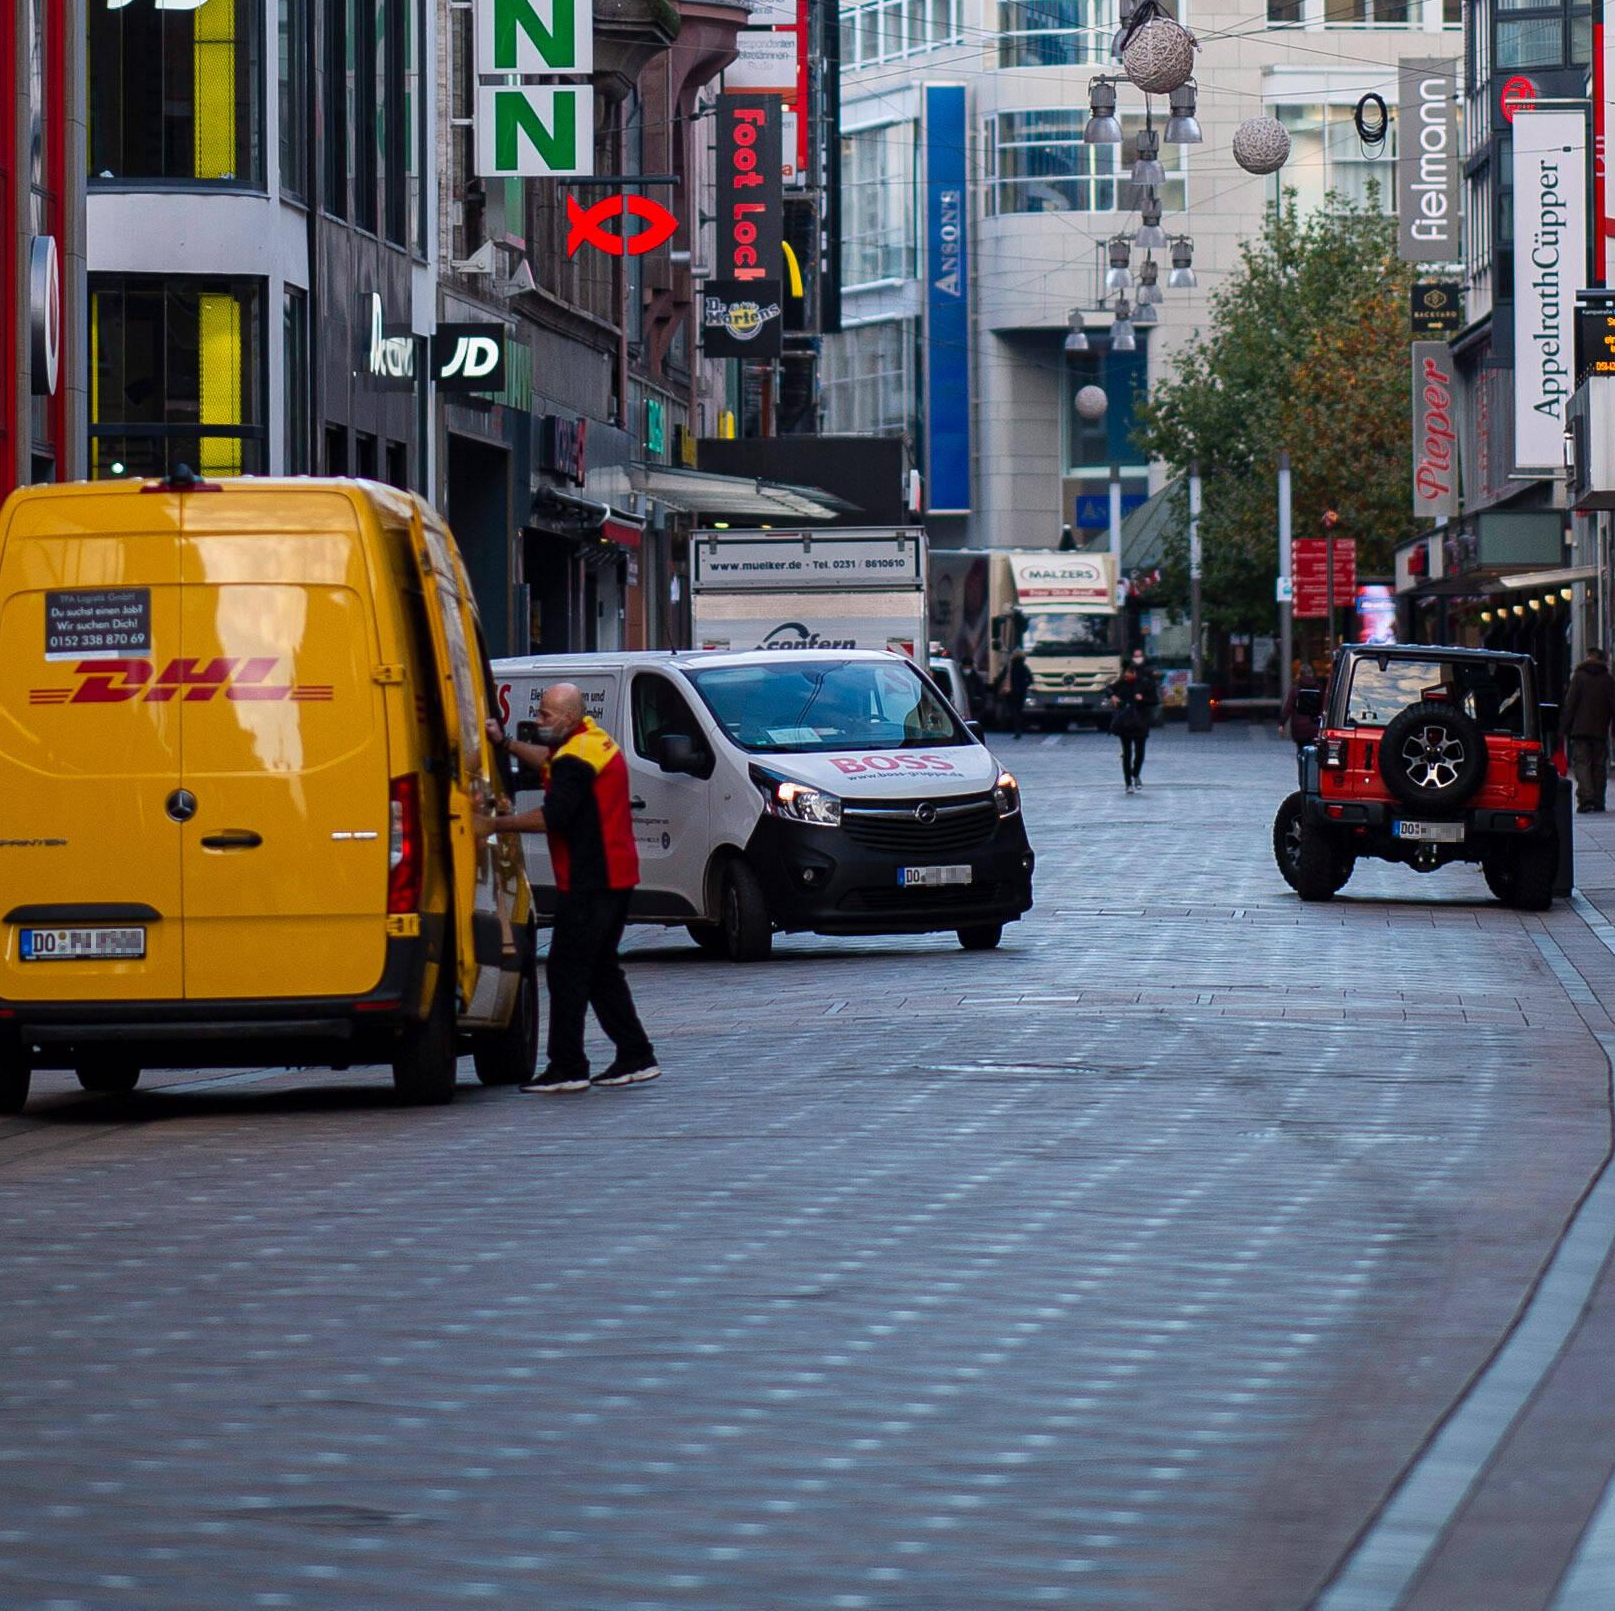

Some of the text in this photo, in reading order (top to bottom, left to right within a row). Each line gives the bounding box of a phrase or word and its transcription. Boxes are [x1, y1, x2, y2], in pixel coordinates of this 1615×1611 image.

[733, 109, 766, 189] Foot
[1411, 78, 1448, 240] fielmann
[1532, 160, 1568, 420] AppelrathCüpper
[441, 337, 499, 378] JD
[1416, 357, 1456, 499] Pieper
[833, 559, 856, 569] 0231
[1029, 570, 1093, 579] MALZERS
[51, 607, 65, 617] Du
[95, 607, 120, 616] einen
[57, 618, 138, 631] Wir suchen Dich!
[50, 633, 145, 647] 0152 338 870 69
[72, 659, 291, 702] DHL
[829, 755, 954, 774] BOSS
[848, 770, 964, 781] www.boss-gruppe.de
[1400, 823, 1415, 835] DO
[906, 869, 920, 883] DO
[34, 933, 56, 952] DO
